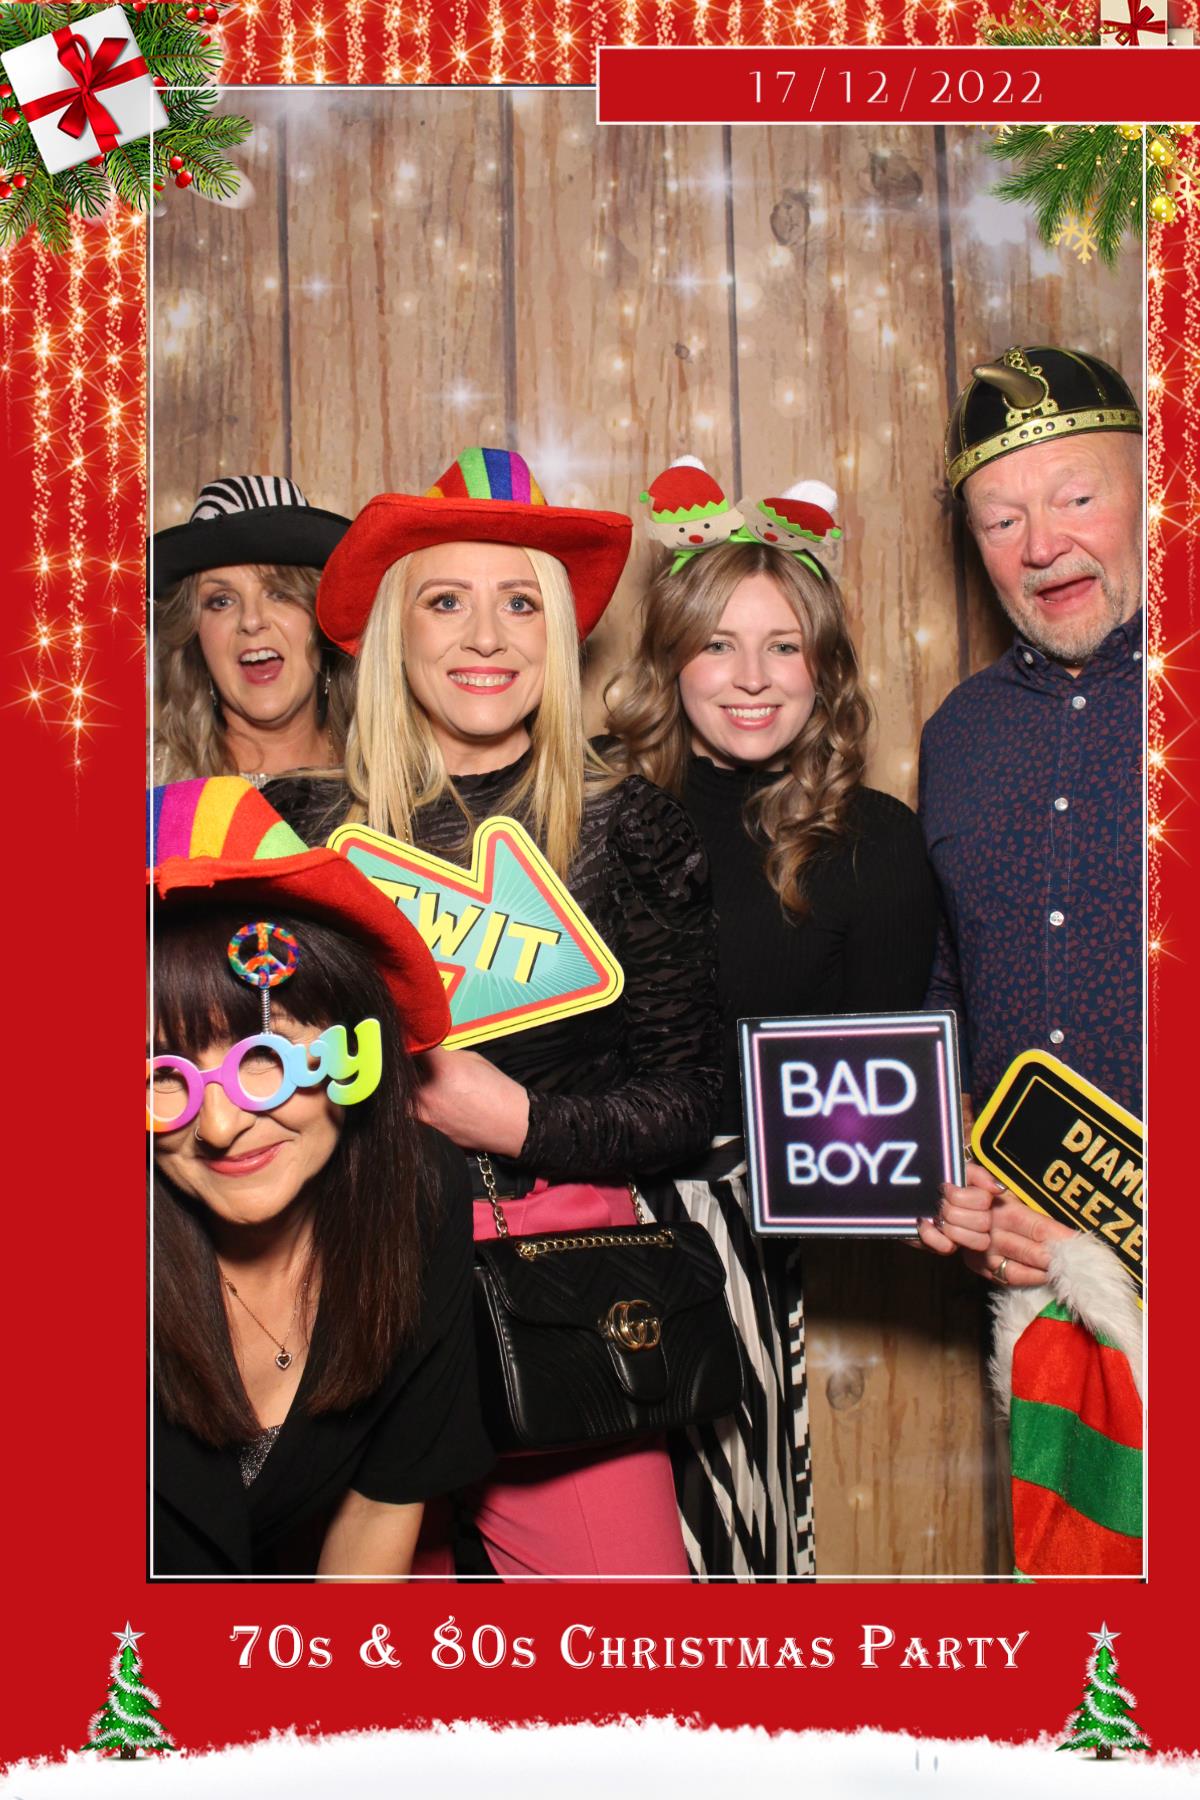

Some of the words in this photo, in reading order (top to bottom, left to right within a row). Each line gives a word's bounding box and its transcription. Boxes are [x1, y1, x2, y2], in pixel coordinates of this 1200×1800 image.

[779, 1058, 918, 1118] BAD
[785, 1141, 921, 1186] BOYZ
[1042, 1159, 1144, 1265] GEEZE
